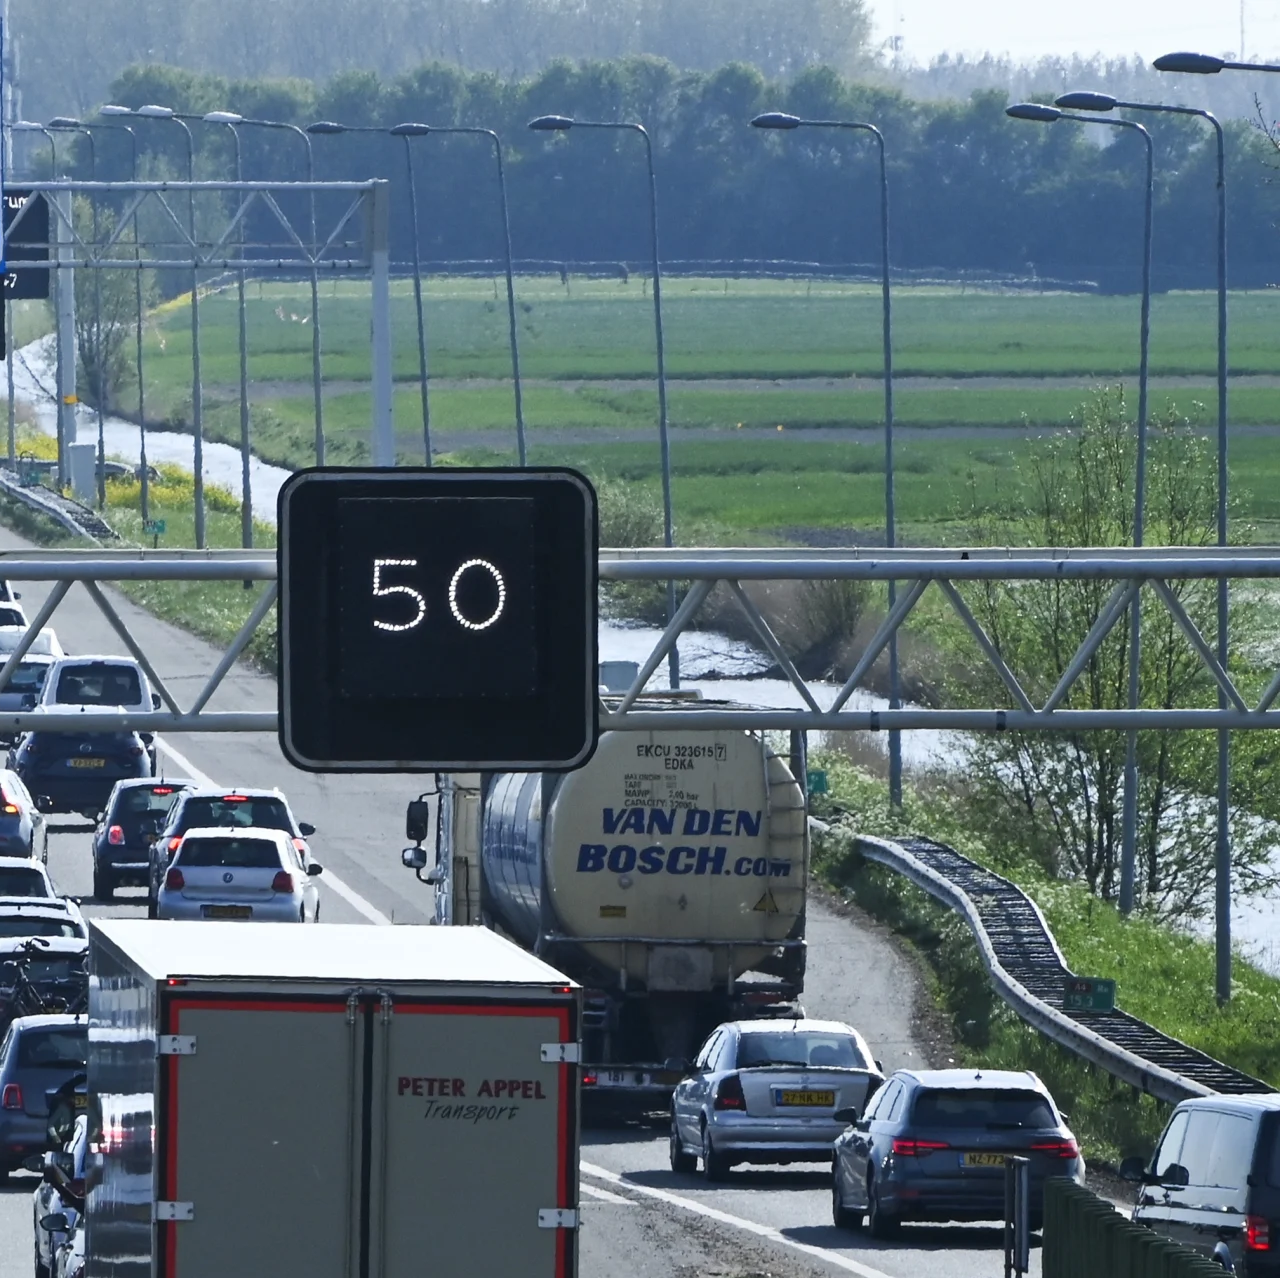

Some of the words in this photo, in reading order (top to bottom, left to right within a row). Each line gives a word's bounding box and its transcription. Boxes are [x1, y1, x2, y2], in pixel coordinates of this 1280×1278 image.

[372, 557, 507, 632] 50
[636, 745, 670, 757] EKCU
[675, 746, 713, 759] 323615
[665, 758, 694, 770] EDKA
[603, 808, 676, 835] VAN
[683, 809, 762, 837] DEN
[397, 1077, 470, 1099] PETER
[477, 1078, 546, 1100] APPEL
[424, 1099, 520, 1123] Transport
